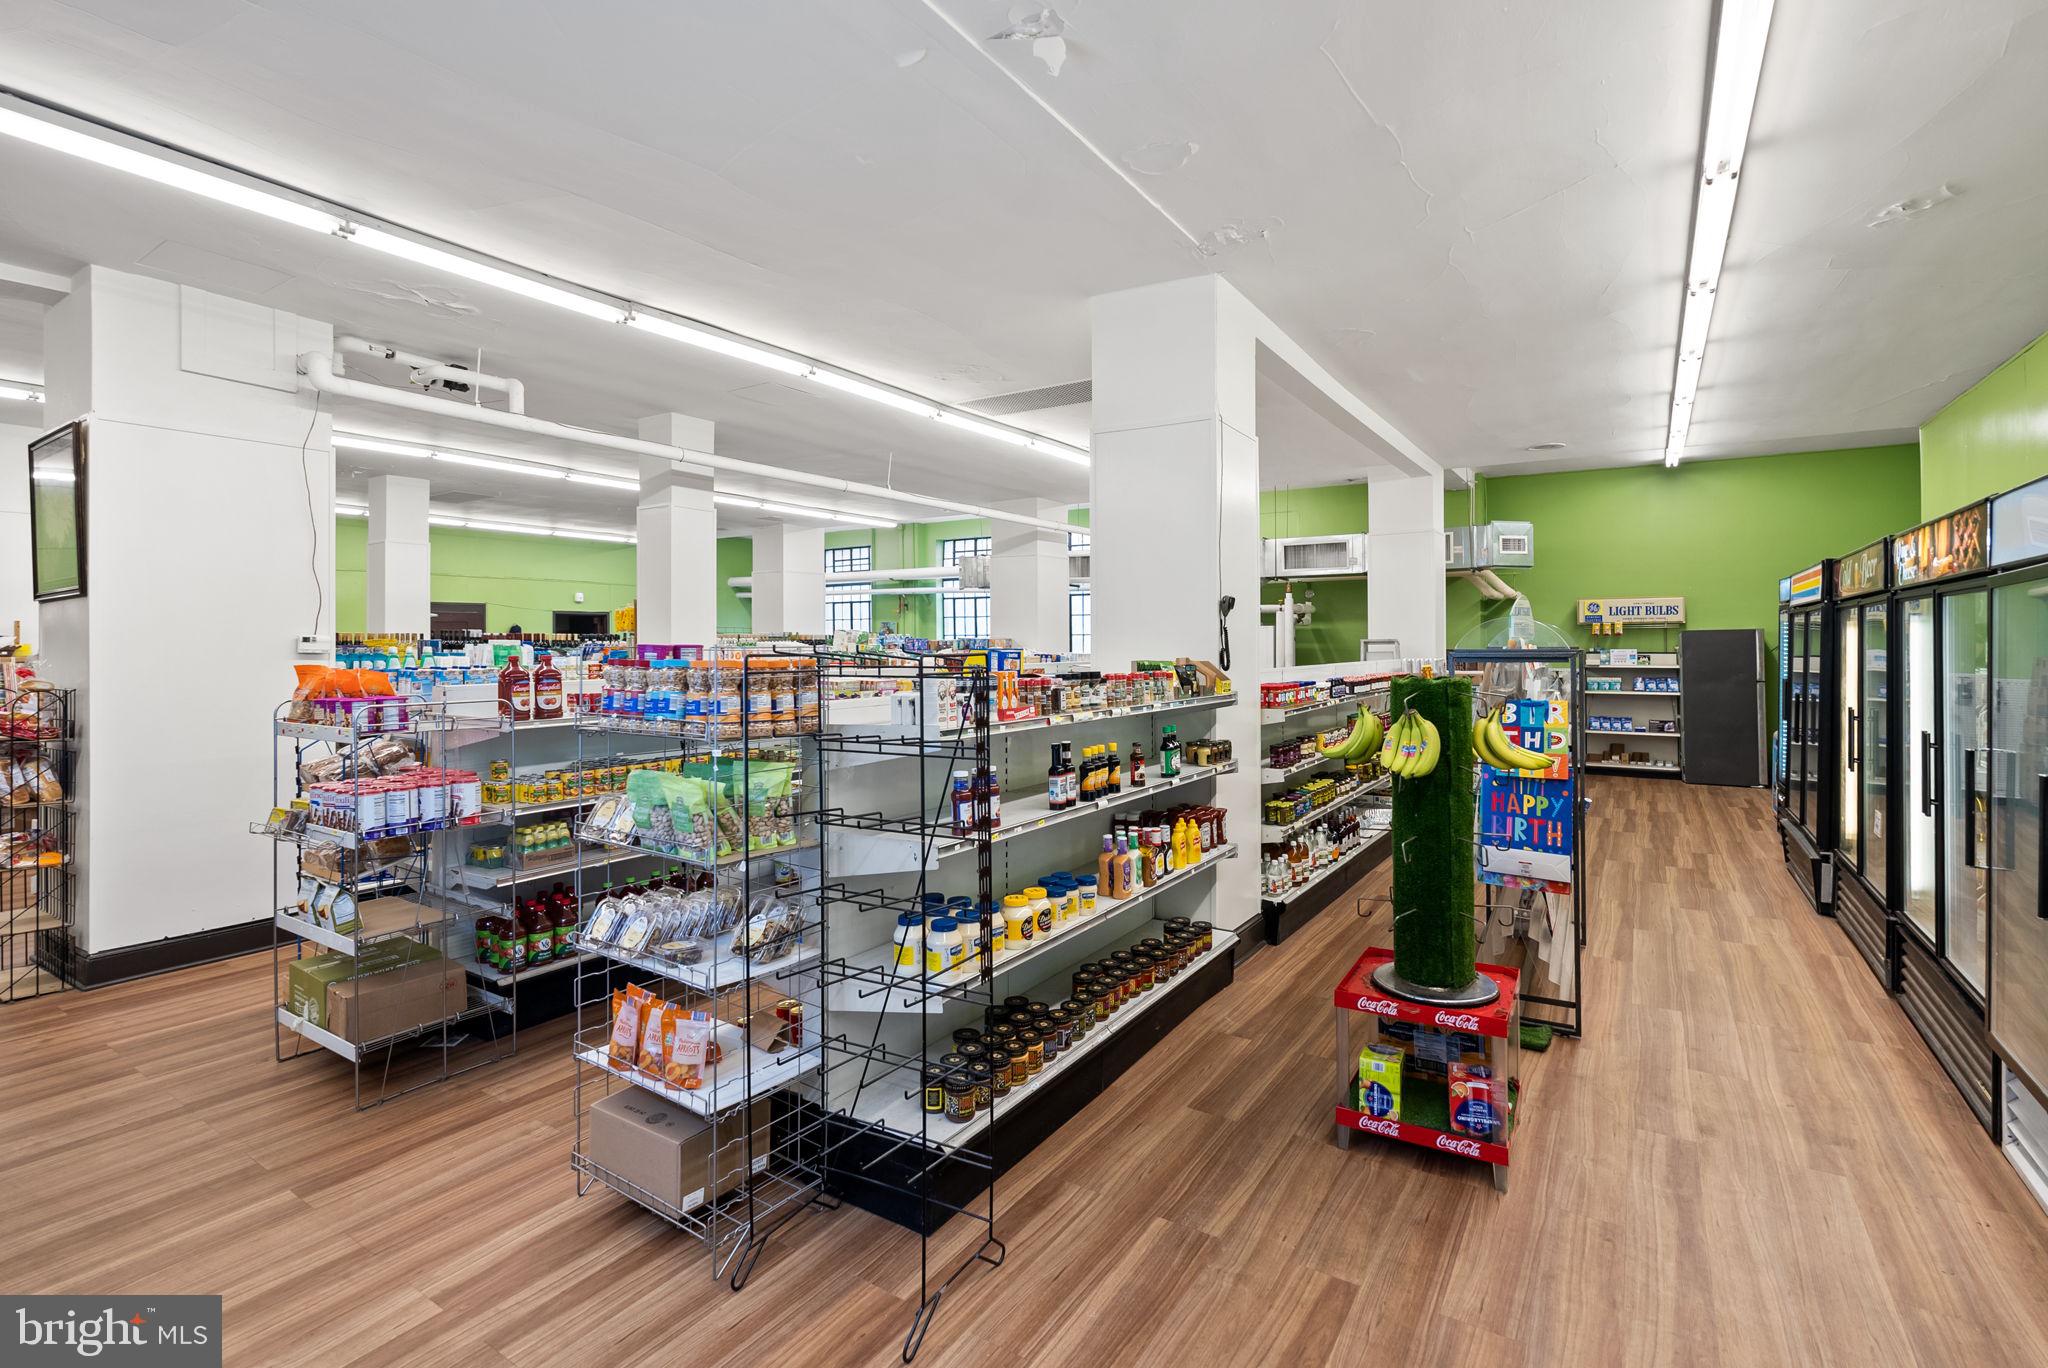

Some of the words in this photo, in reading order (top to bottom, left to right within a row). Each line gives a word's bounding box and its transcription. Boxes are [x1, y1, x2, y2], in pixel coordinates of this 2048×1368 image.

[1860, 553, 1878, 588] Beer
[1609, 606, 1643, 616] LIGHT
[1645, 605, 1679, 616] BULBS
[1491, 791, 1564, 818] HAPPY
[1491, 815, 1563, 848] BIRTH
[1357, 996, 1399, 1016] Coca-Cola
[1435, 1010, 1480, 1031] Coca-Cola
[1359, 1115, 1400, 1137] Coca-Cola
[1436, 1135, 1481, 1157] Coca-Cola
